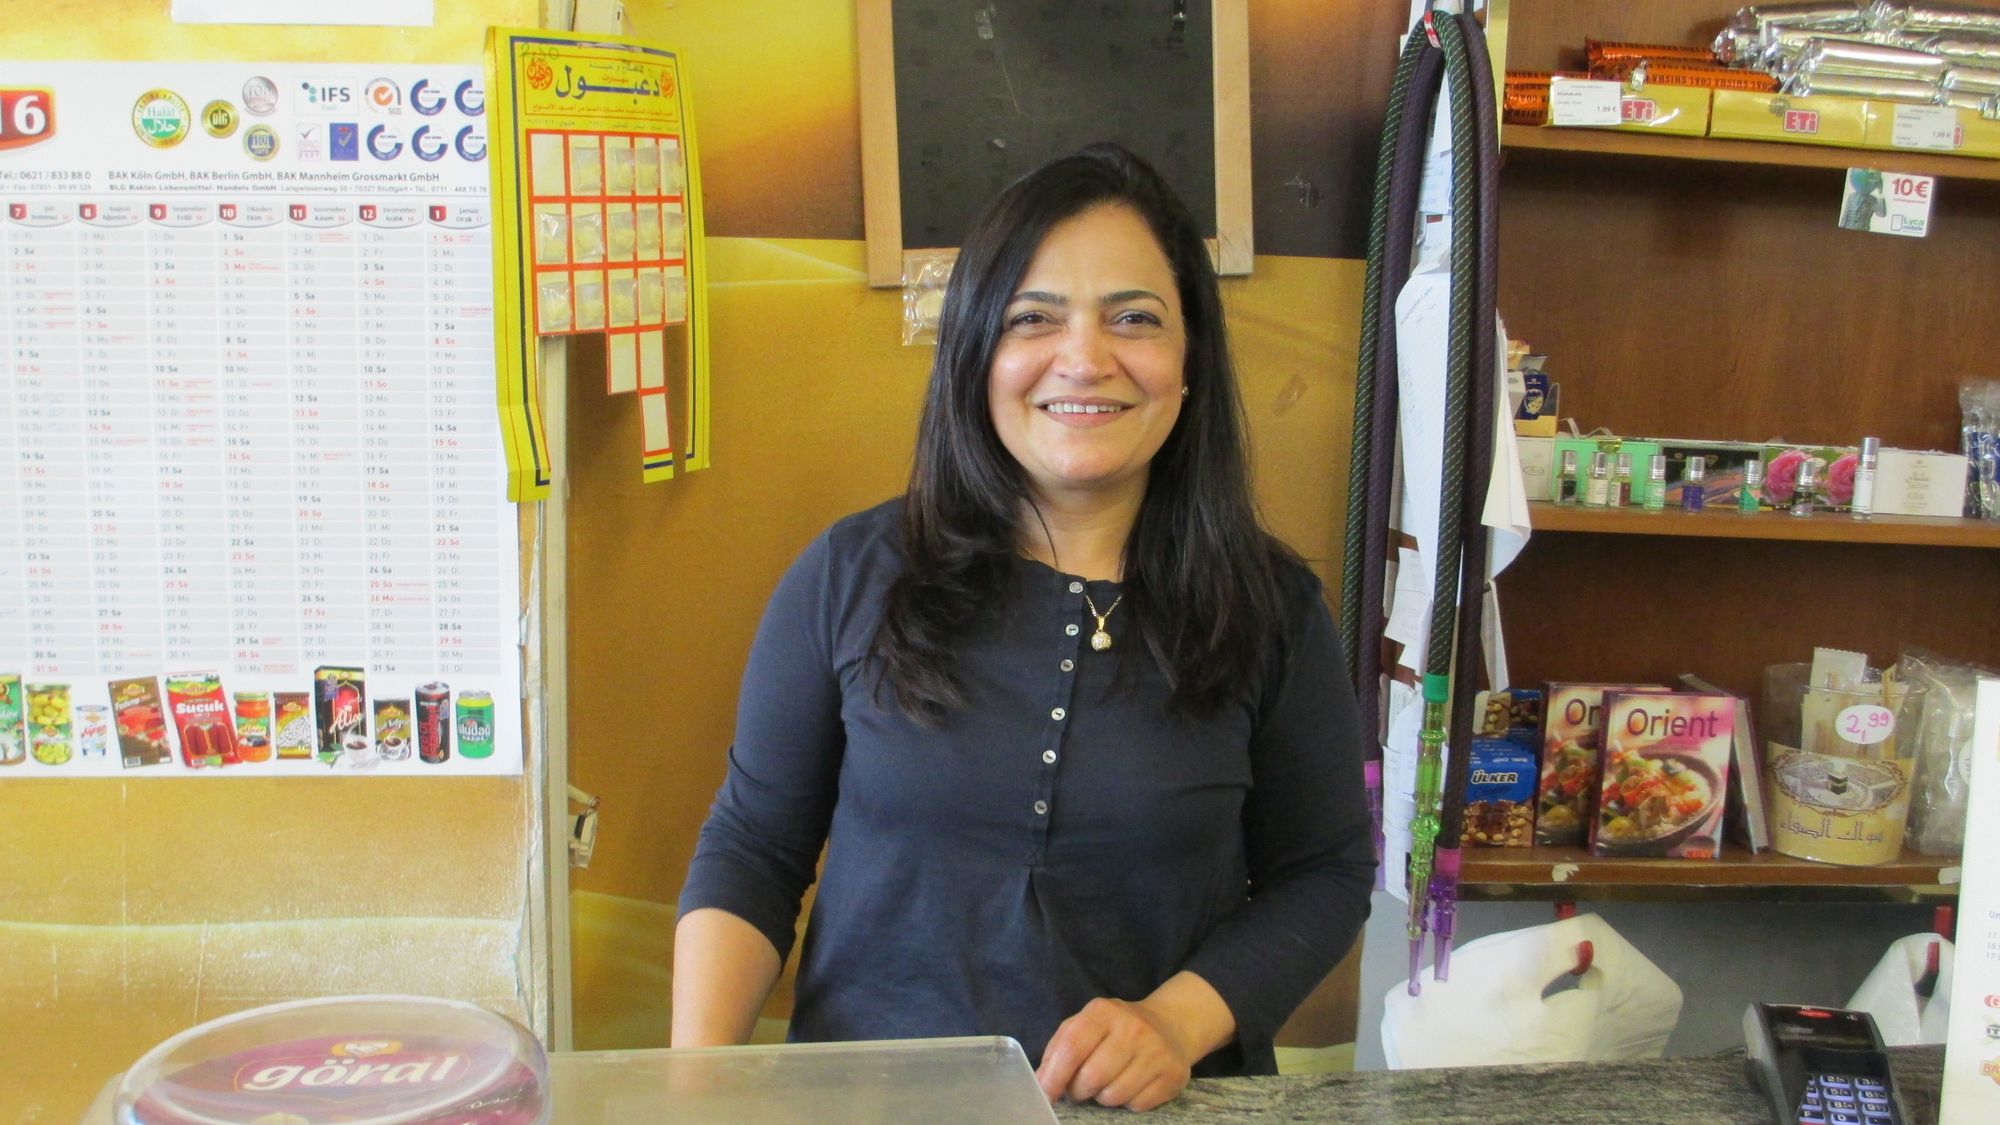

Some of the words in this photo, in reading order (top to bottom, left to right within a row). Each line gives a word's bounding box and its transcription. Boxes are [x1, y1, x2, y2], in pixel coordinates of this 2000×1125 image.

[322, 87, 351, 103] IFS
[0, 95, 45, 134] 6
[20, 171, 42, 180] 0621
[51, 171, 69, 180] 833
[71, 171, 84, 180] 88
[109, 171, 128, 180] BAK
[130, 171, 153, 180] Köln
[189, 171, 209, 180] BAK
[212, 171, 239, 181] Berlin
[277, 172, 296, 181] BAK
[299, 172, 350, 181] Mannheim
[352, 172, 407, 182] Grossmarkt
[410, 172, 439, 181] GmbH
[222, 208, 234, 217] 10
[293, 209, 302, 219] 11
[362, 209, 374, 219] 12
[374, 263, 384, 271] Sa
[445, 322, 455, 330] Sa
[377, 365, 386, 373] Sa
[379, 466, 389, 474] Sa
[452, 622, 461, 630] Sa
[176, 699, 224, 714] Sucuk
[1626, 707, 1719, 738] Orient
[1471, 769, 1519, 785] ÜLKER
[243, 1055, 459, 1092] göral
